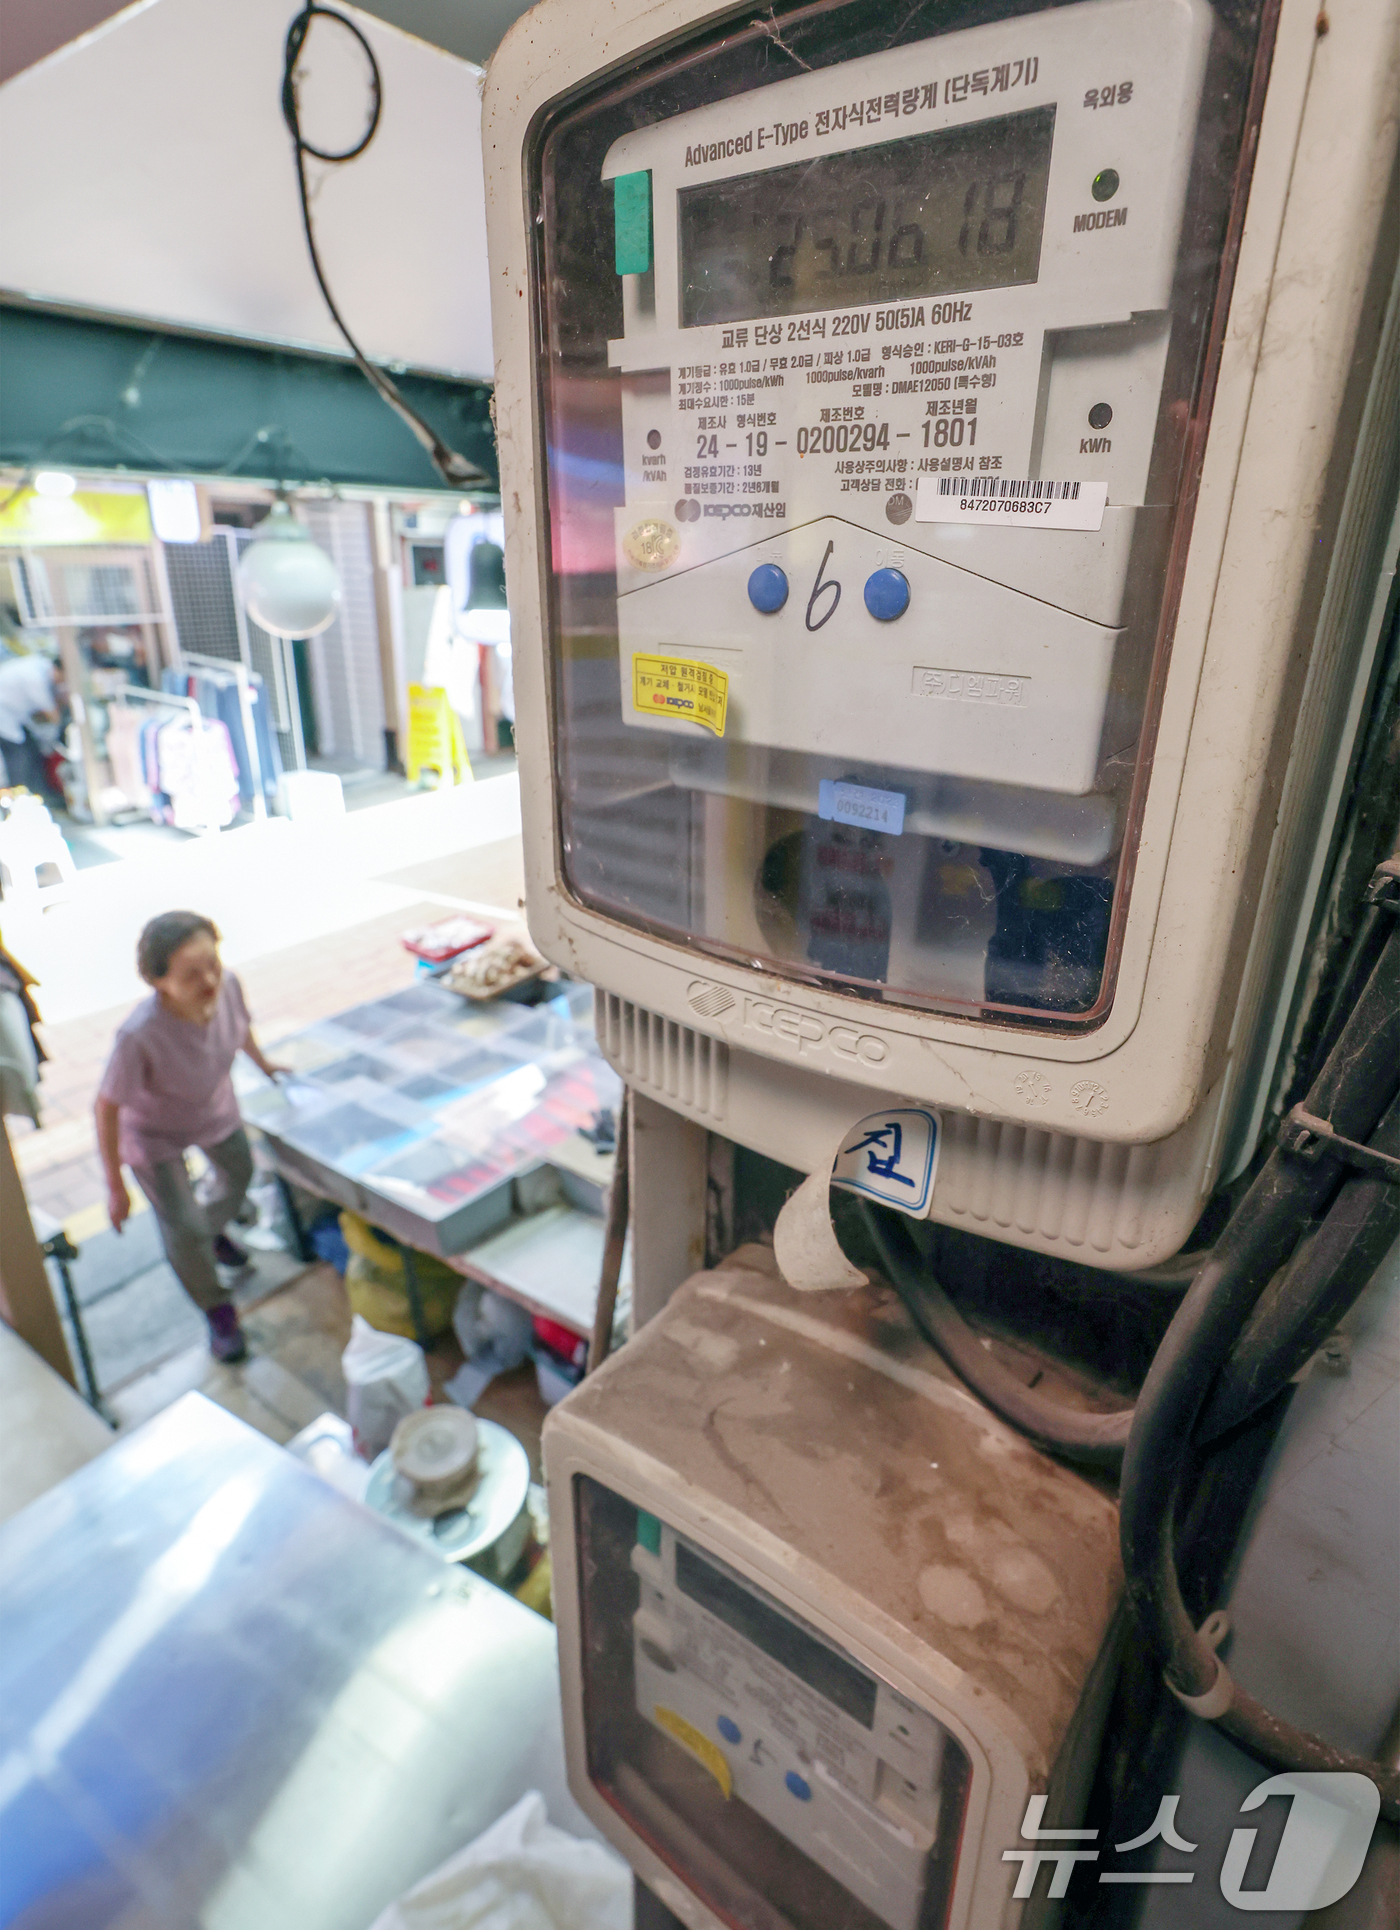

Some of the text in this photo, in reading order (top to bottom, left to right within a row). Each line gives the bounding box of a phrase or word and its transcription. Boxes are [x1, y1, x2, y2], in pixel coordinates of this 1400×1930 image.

[1083, 81, 1134, 111] 옥외용
[683, 130, 754, 168] Advanced
[757, 115, 809, 152] E-Type
[814, 80, 938, 136] 전자식전력량계
[1073, 207, 1129, 233] MODEM
[721, 327, 750, 350] 교류
[754, 322, 784, 346] 단상
[787, 316, 827, 343] 2선식
[831, 312, 872, 337] 220V
[931, 300, 973, 325] 60Hz
[881, 341, 925, 361] 형식승인
[719, 361, 736, 376] 유효
[739, 358, 761, 374] 1.0급
[769, 356, 788, 371] 무효
[791, 353, 814, 369] 2.0급
[823, 350, 844, 366] 피상
[847, 347, 872, 363] 1.0급
[909, 354, 997, 376] 1000pulse/kVAh
[719, 374, 785, 392] 1000pulse/kWh
[805, 366, 886, 385] 1000pulse/kvarh
[851, 382, 883, 398] 모델명
[891, 376, 951, 395] DMAE12050
[736, 392, 756, 407] 15분
[925, 397, 978, 417] 제조년월
[697, 410, 777, 431] 제조사 형식번호
[819, 405, 866, 424] 제조번호
[696, 433, 720, 460] 24
[746, 431, 768, 457] 19
[796, 422, 891, 456] 0200294
[920, 416, 979, 449] 1801
[1079, 437, 1112, 454] kWh
[641, 453, 667, 466] kvarh
[834, 458, 909, 475] 사용상주의사항
[916, 455, 975, 472] 사용설명서
[978, 455, 1003, 471] 참조
[742, 463, 763, 477] 13년
[840, 477, 882, 493] 고객상담
[884, 477, 907, 492] 전화
[959, 498, 1053, 515] 8472070683C7
[805, 539, 842, 632] 6
[836, 799, 889, 823] 0092214
[743, 996, 892, 1070] KEPCO
